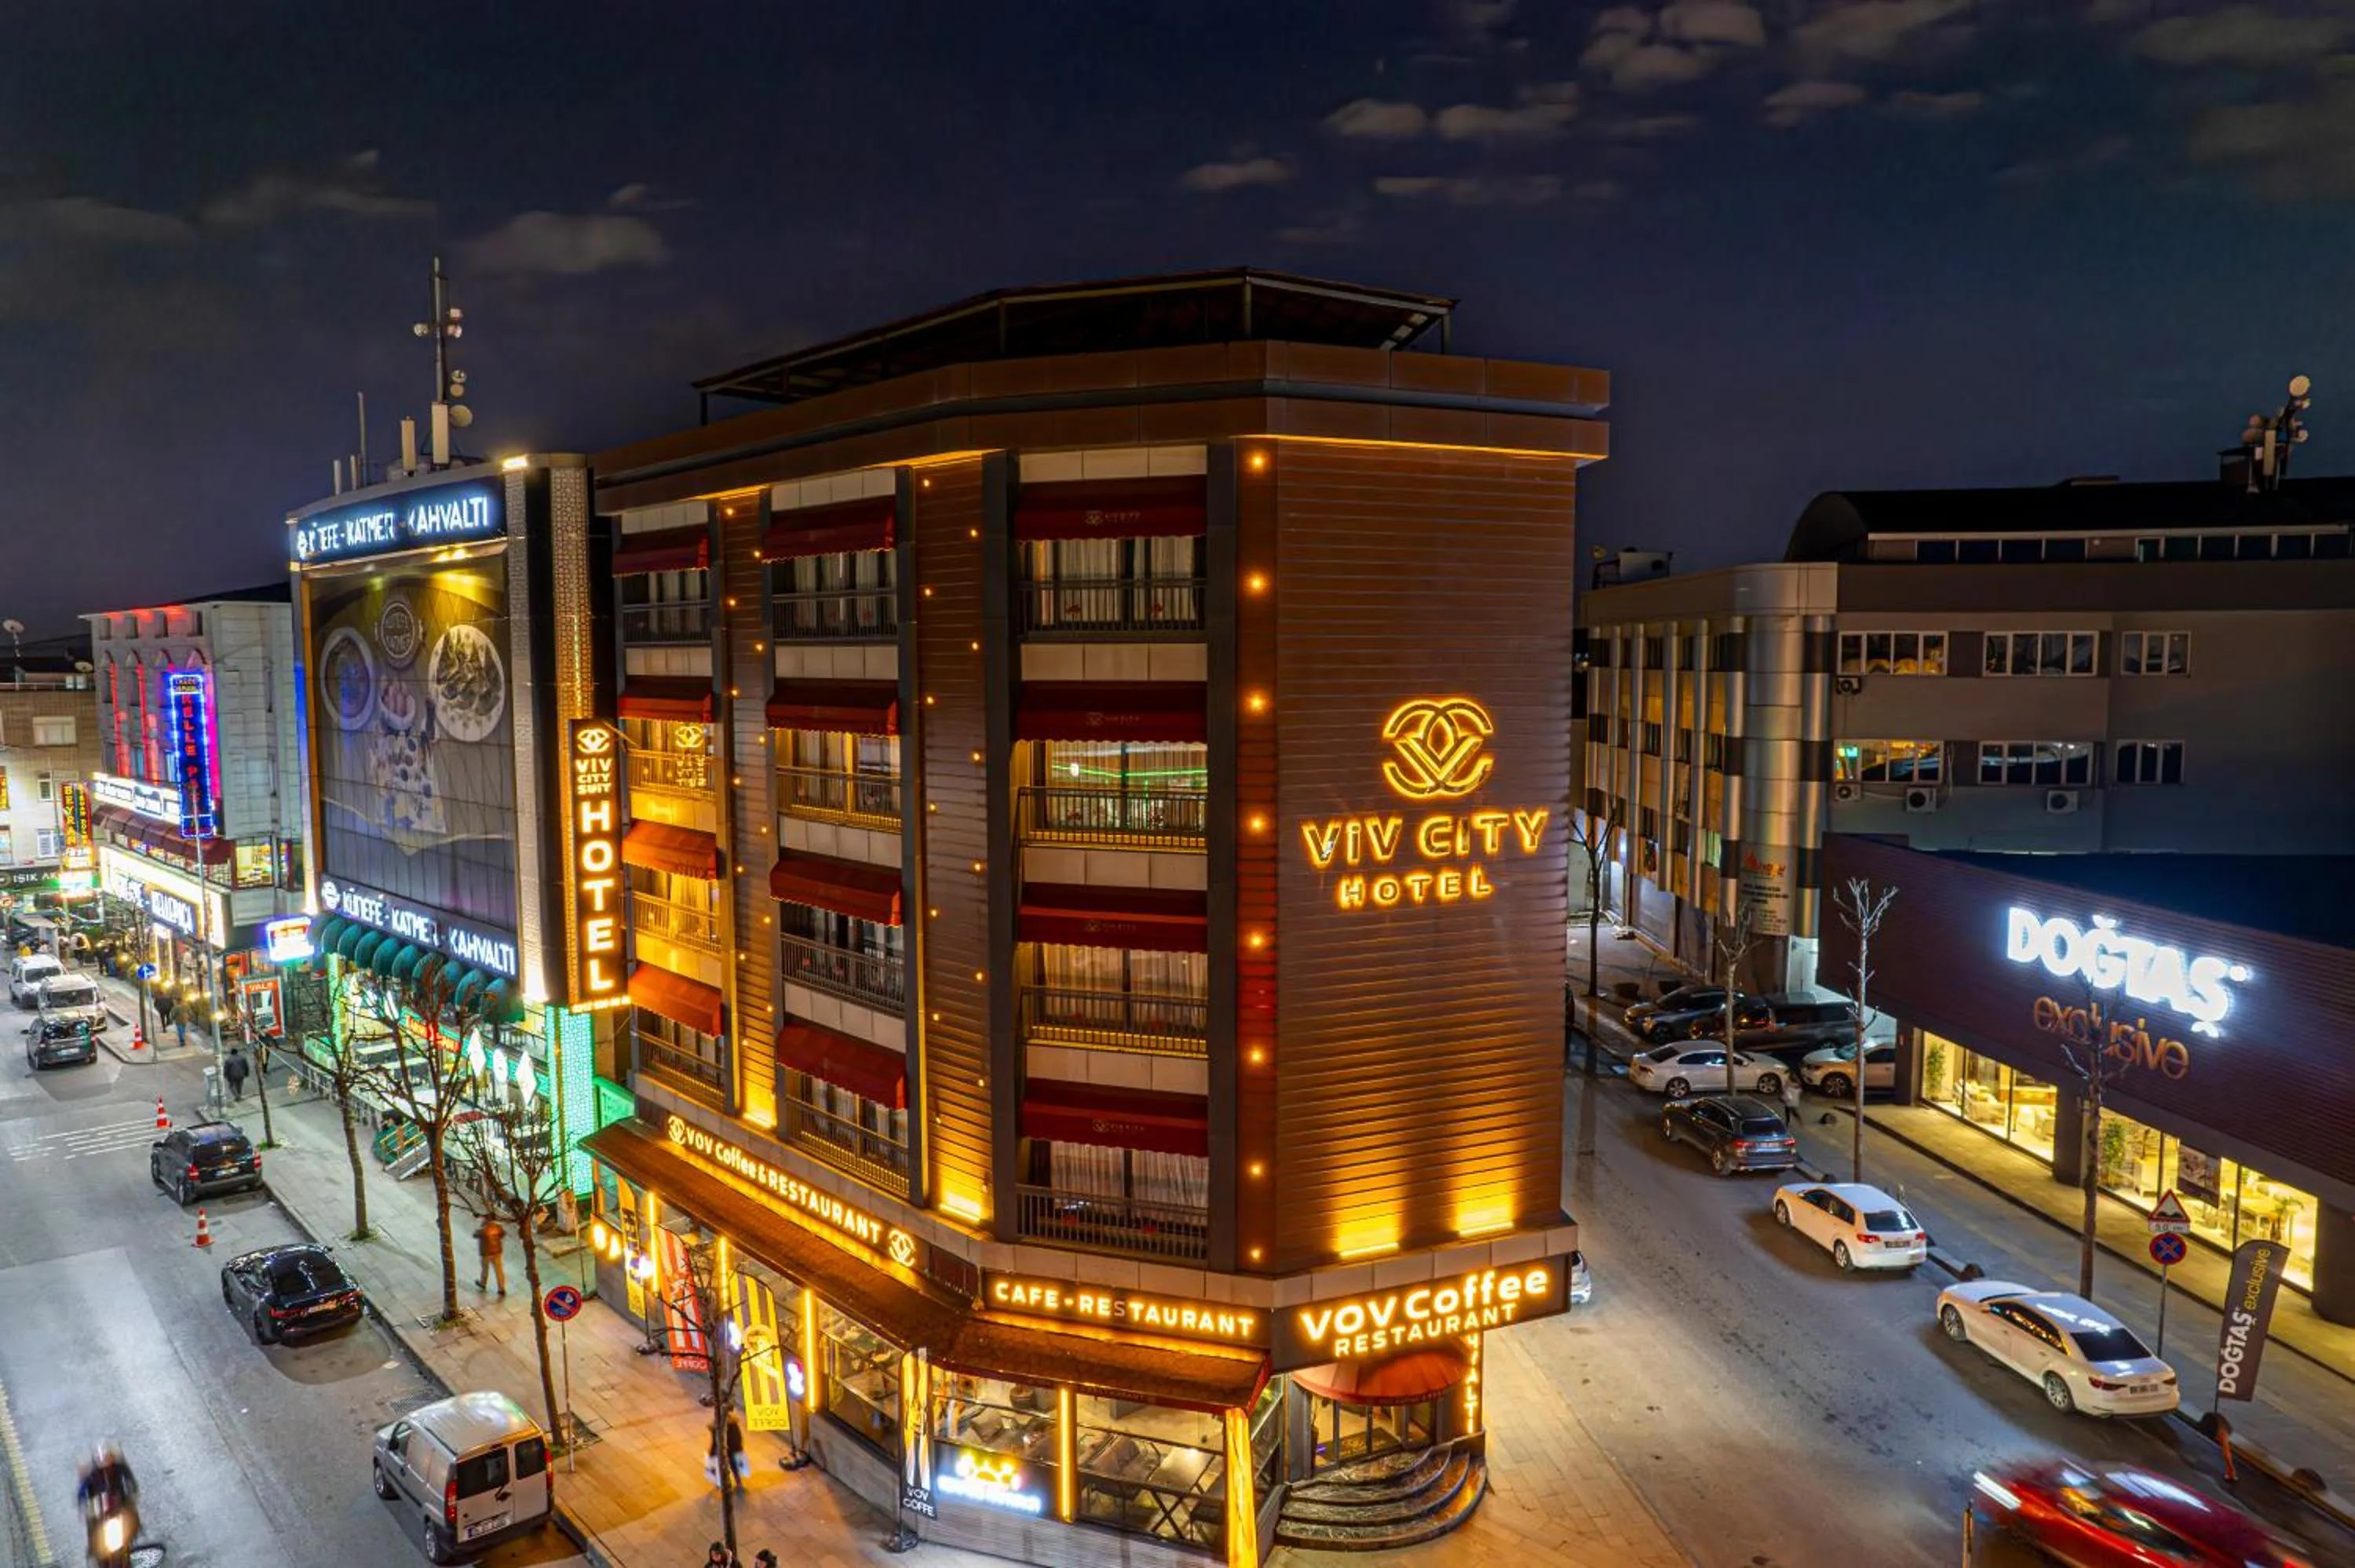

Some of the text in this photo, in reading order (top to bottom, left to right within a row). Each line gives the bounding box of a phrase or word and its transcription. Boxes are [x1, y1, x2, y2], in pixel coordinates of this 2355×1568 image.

[407, 496, 488, 536] KAHVALTI
[575, 757, 612, 773] VIV
[577, 773, 611, 784] CITY
[1418, 809, 1550, 858] CITY
[579, 799, 615, 991] HOTEL
[1338, 866, 1493, 910] HOTEL
[449, 928, 516, 976] KAHVALTI
[2007, 906, 2230, 1038] DOĞTAŞ
[686, 1125, 713, 1155] VOV
[715, 1140, 758, 1180] Coffee
[769, 1168, 882, 1245] RESTAURANT
[1299, 1268, 1549, 1343] VOV Coffee
[1334, 1301, 1518, 1358] RESTAURANT
[2218, 1249, 2272, 1395] DOĞTAŞ exclusive
[907, 1486, 929, 1502] VOV
